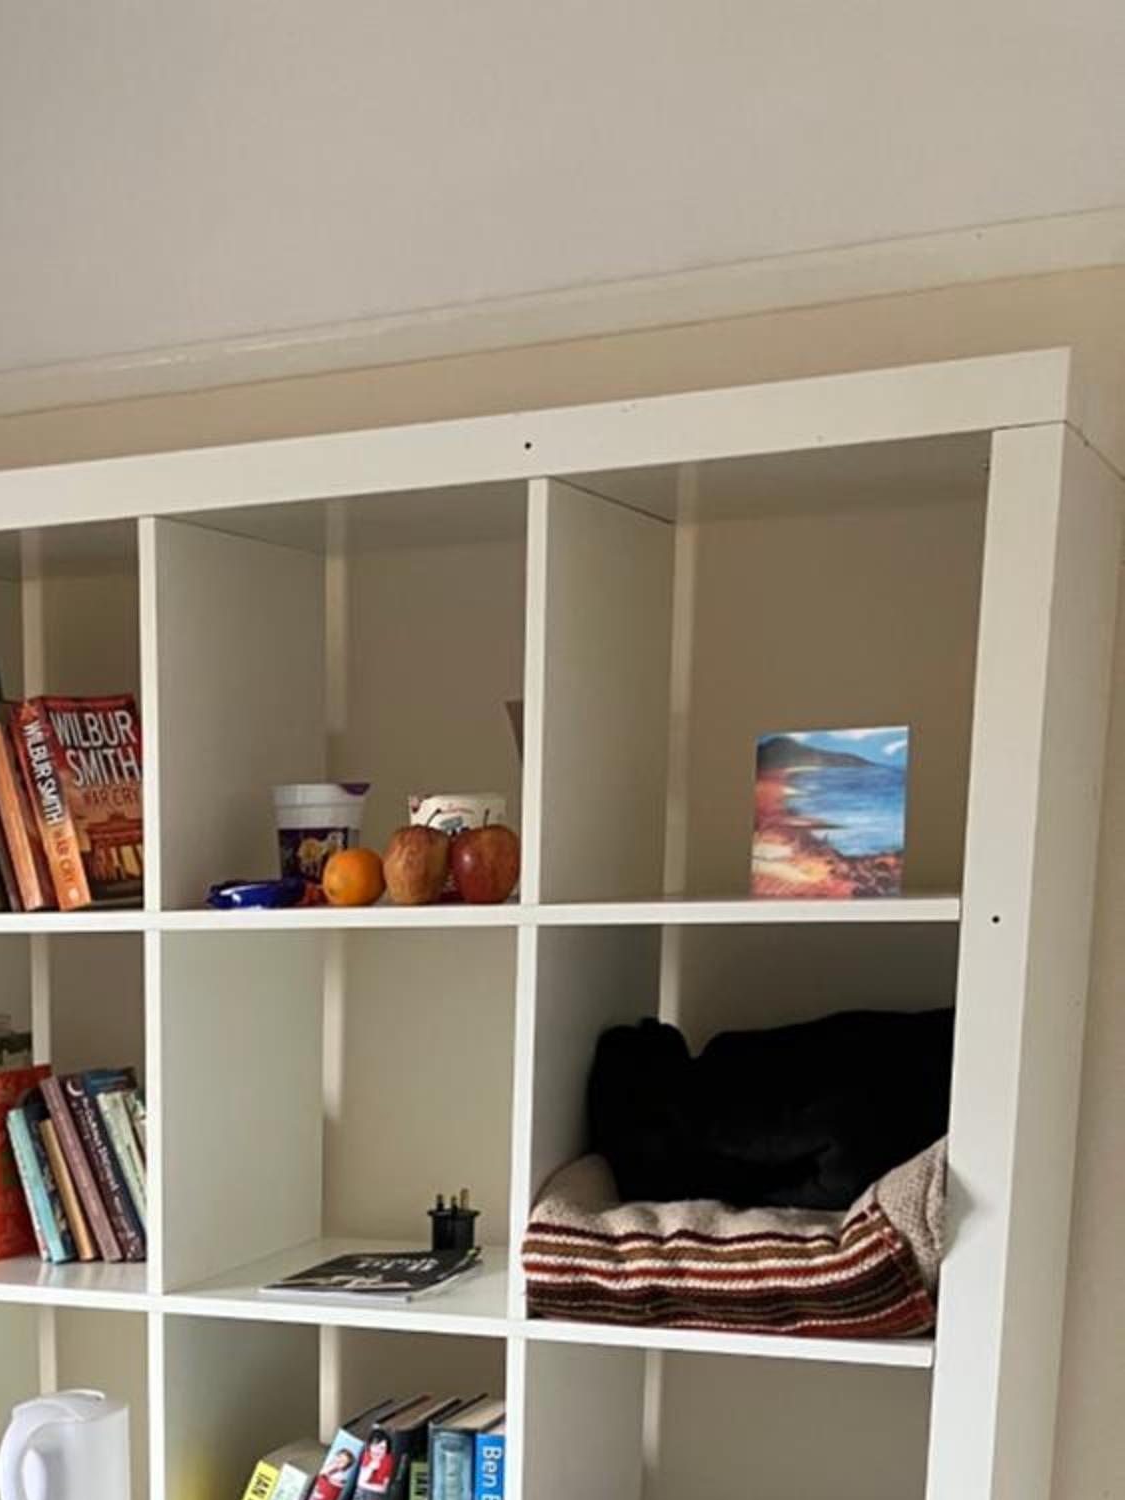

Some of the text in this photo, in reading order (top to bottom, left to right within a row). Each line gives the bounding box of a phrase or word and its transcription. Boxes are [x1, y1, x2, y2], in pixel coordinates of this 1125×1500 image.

[49, 711, 138, 748] WILBUR
[23, 719, 65, 826] WILBUR SMITH
[65, 747, 142, 787] SMITH
[251, 1472, 273, 1499] IAN
[412, 1472, 429, 1495] IAN
[482, 1445, 504, 1488] Ben
